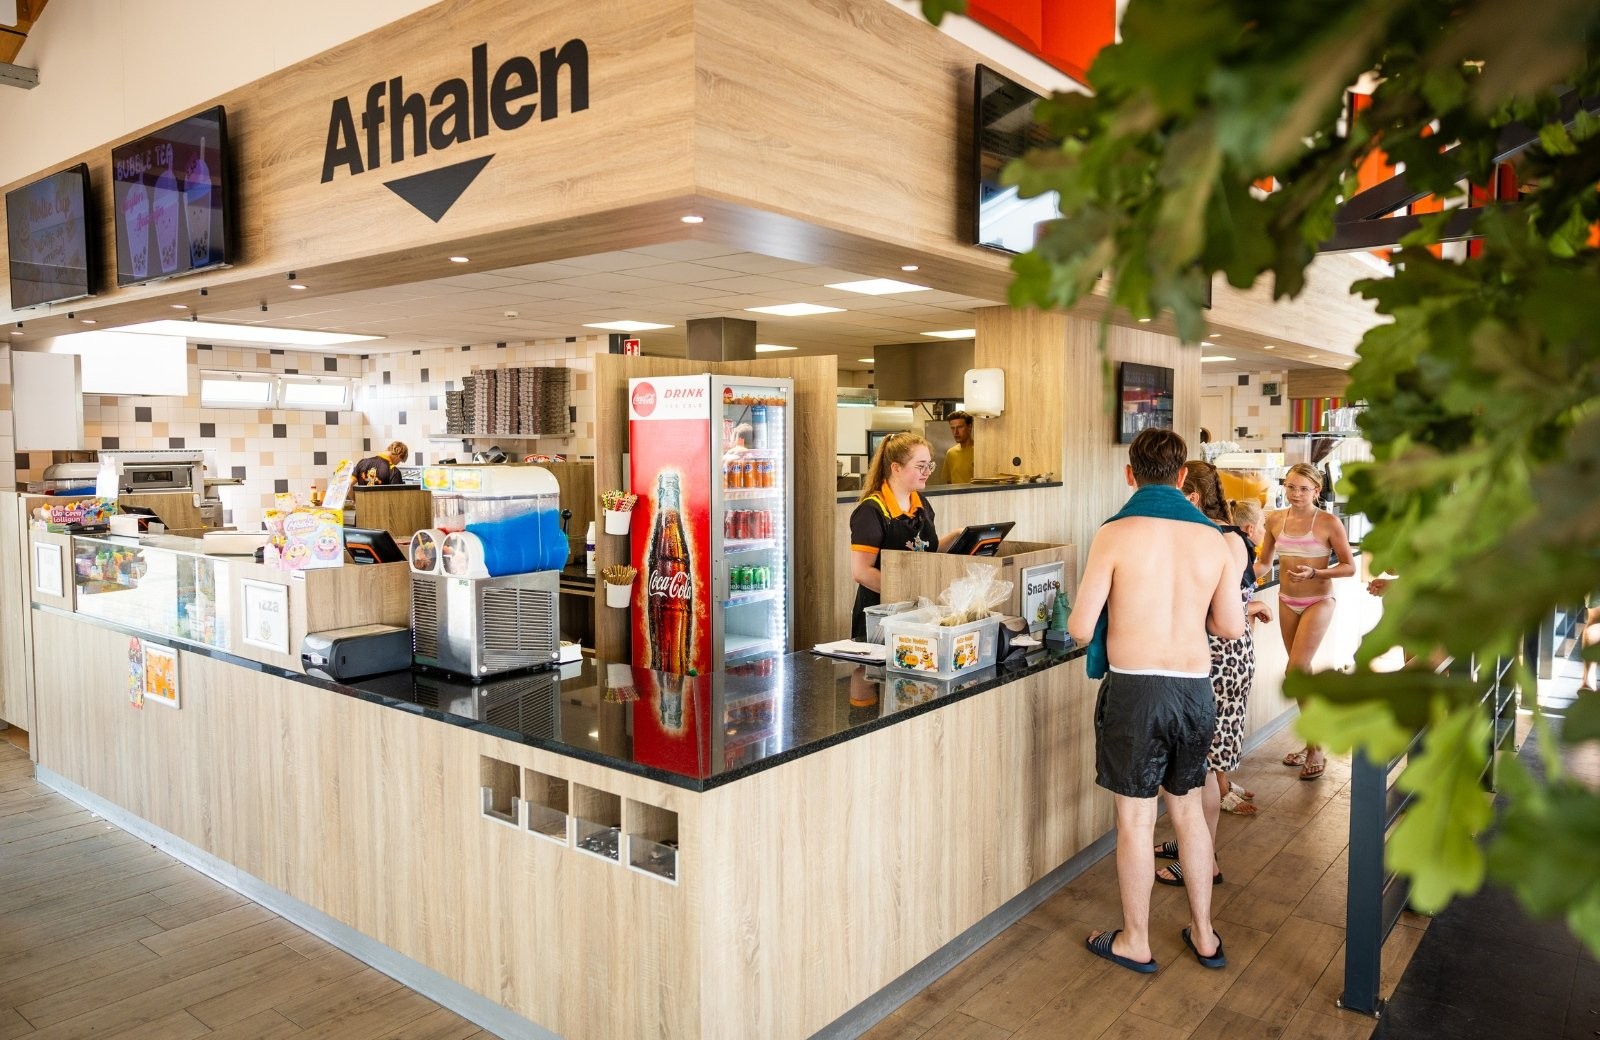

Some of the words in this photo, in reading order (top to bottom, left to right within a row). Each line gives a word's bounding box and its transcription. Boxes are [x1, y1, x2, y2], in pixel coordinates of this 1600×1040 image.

[320, 38, 590, 185] Afhalen
[116, 150, 152, 181] BUBBLE
[155, 142, 174, 168] TEA
[664, 388, 704, 399] DRINK
[648, 569, 692, 600] Coca-Cola
[1027, 578, 1056, 596] Snacks
